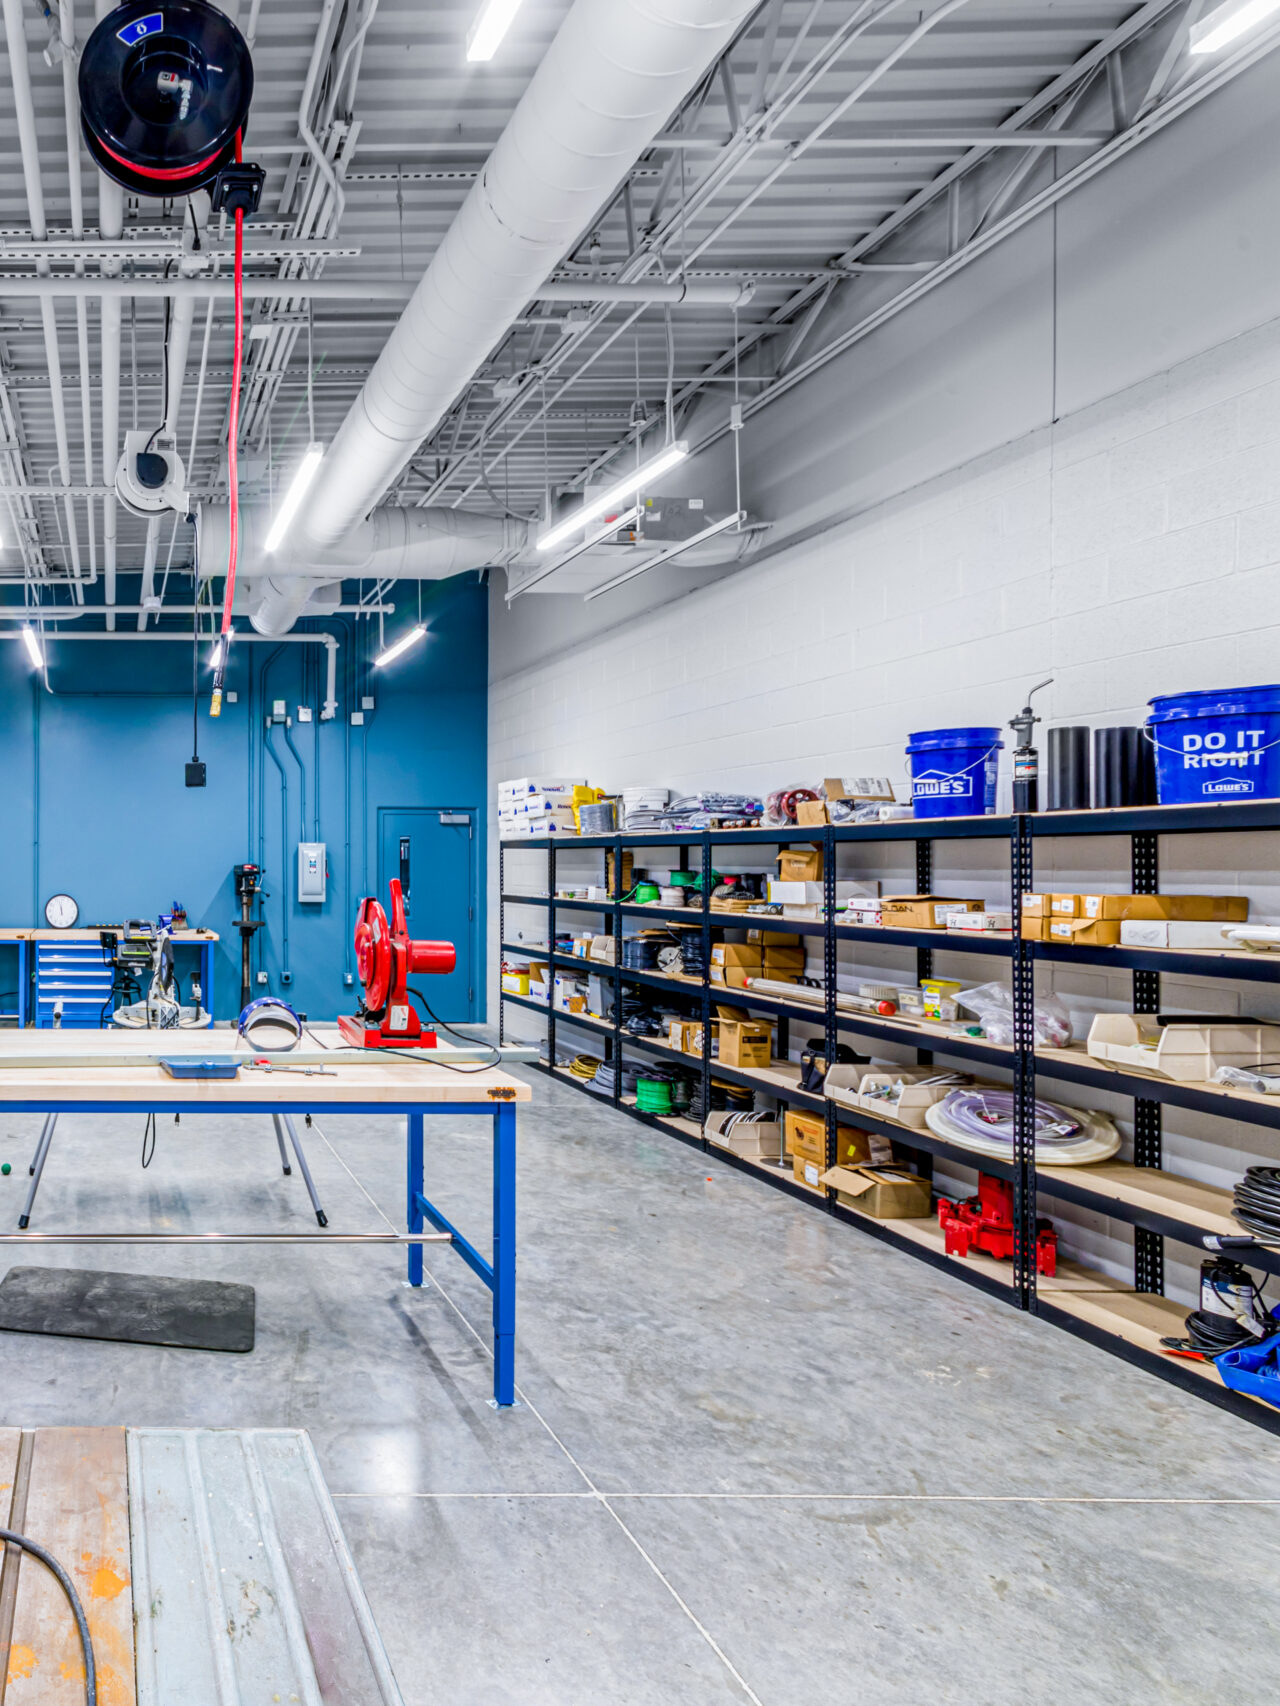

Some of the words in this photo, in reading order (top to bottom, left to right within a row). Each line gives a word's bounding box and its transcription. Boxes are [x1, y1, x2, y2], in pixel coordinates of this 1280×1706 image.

[1183, 732, 1226, 752] DO
[1237, 730, 1265, 748] IT
[1207, 782, 1249, 792] LOWE'S
[880, 904, 914, 912] SLOAN
